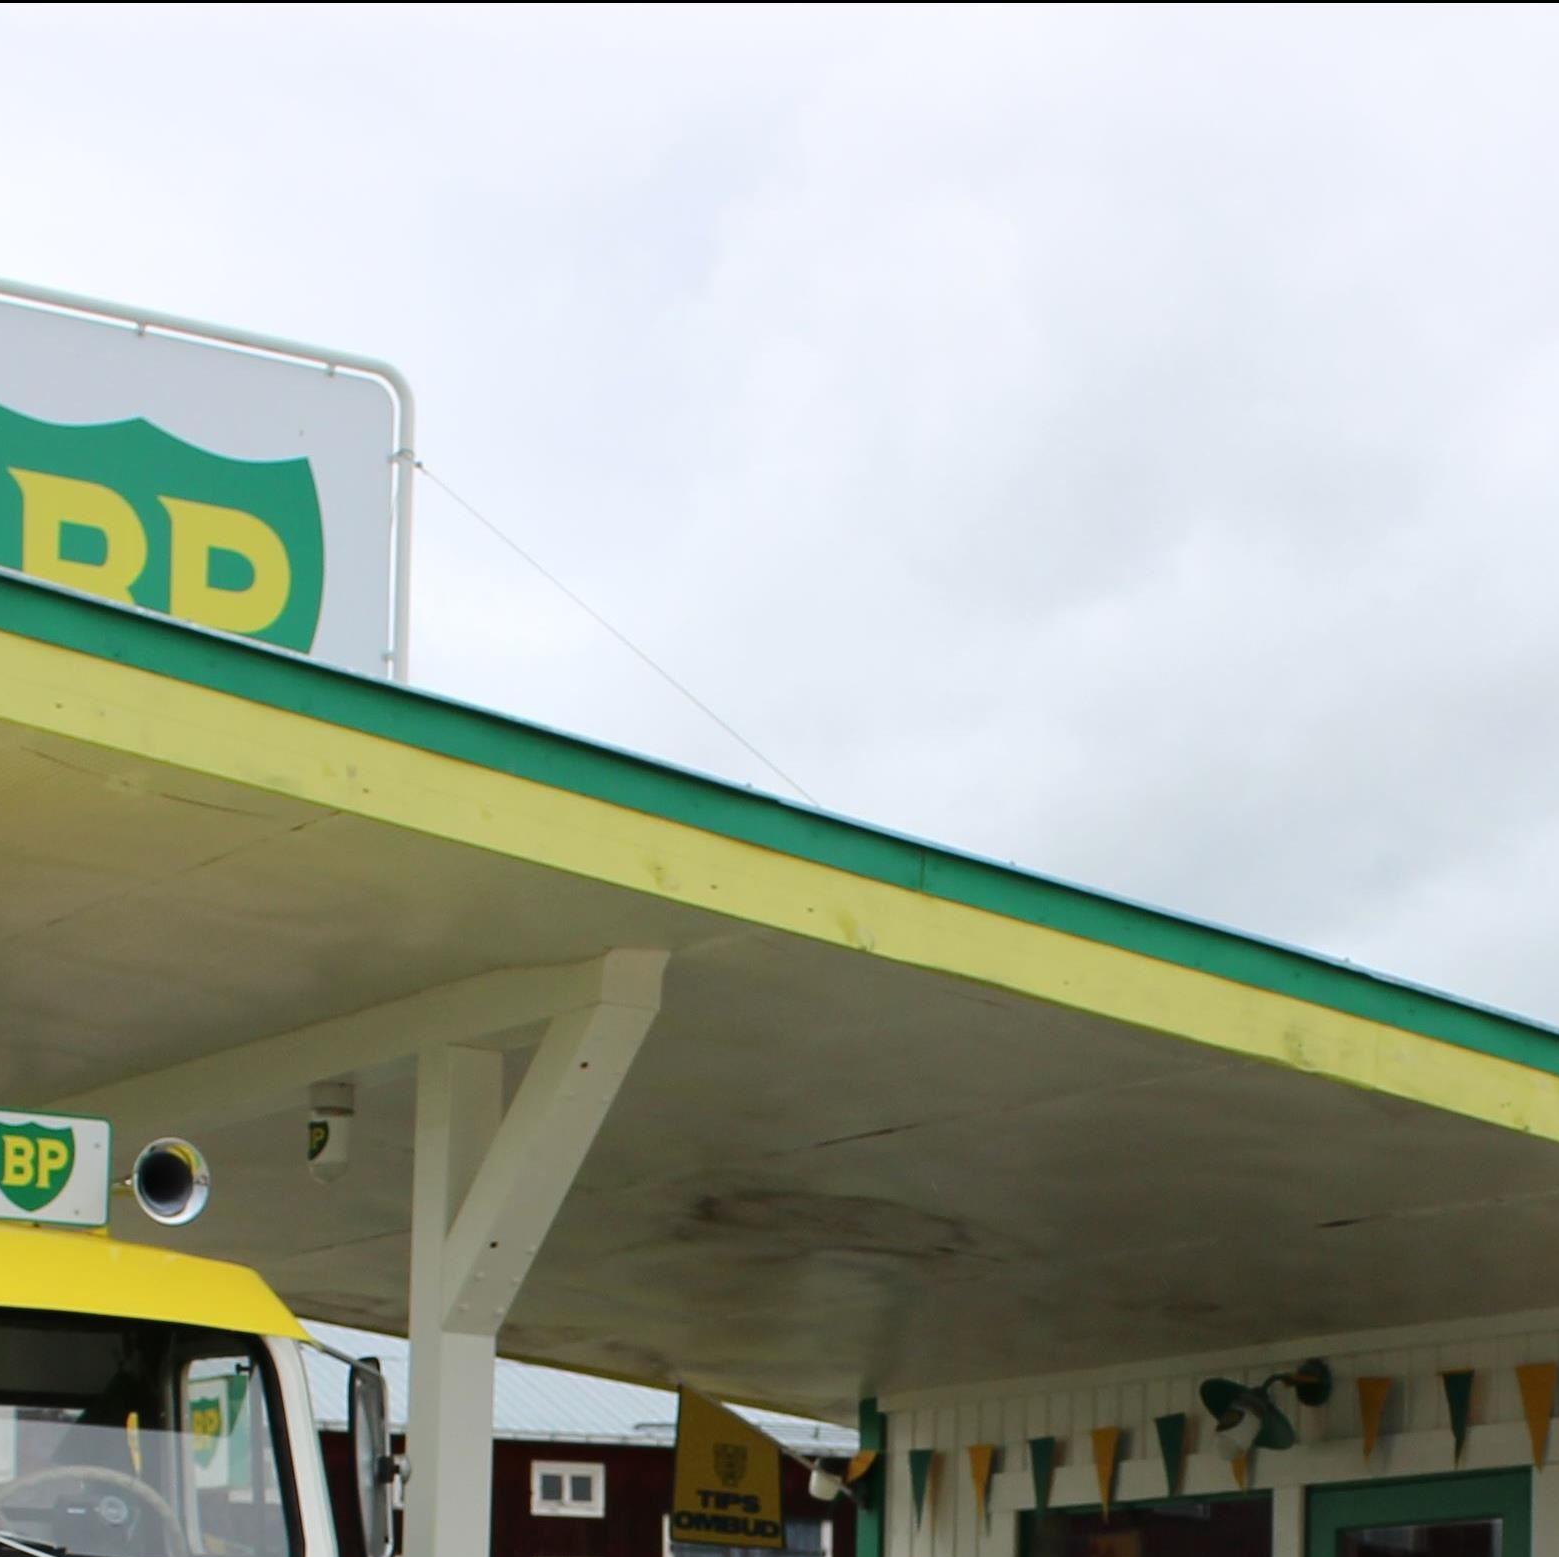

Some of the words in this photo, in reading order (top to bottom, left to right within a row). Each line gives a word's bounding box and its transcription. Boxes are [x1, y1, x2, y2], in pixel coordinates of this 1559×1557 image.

[7, 466, 291, 634] BP
[1, 1135, 70, 1191] BP
[696, 1488, 760, 1514] TIPS
[674, 1509, 780, 1539] OMBUD
